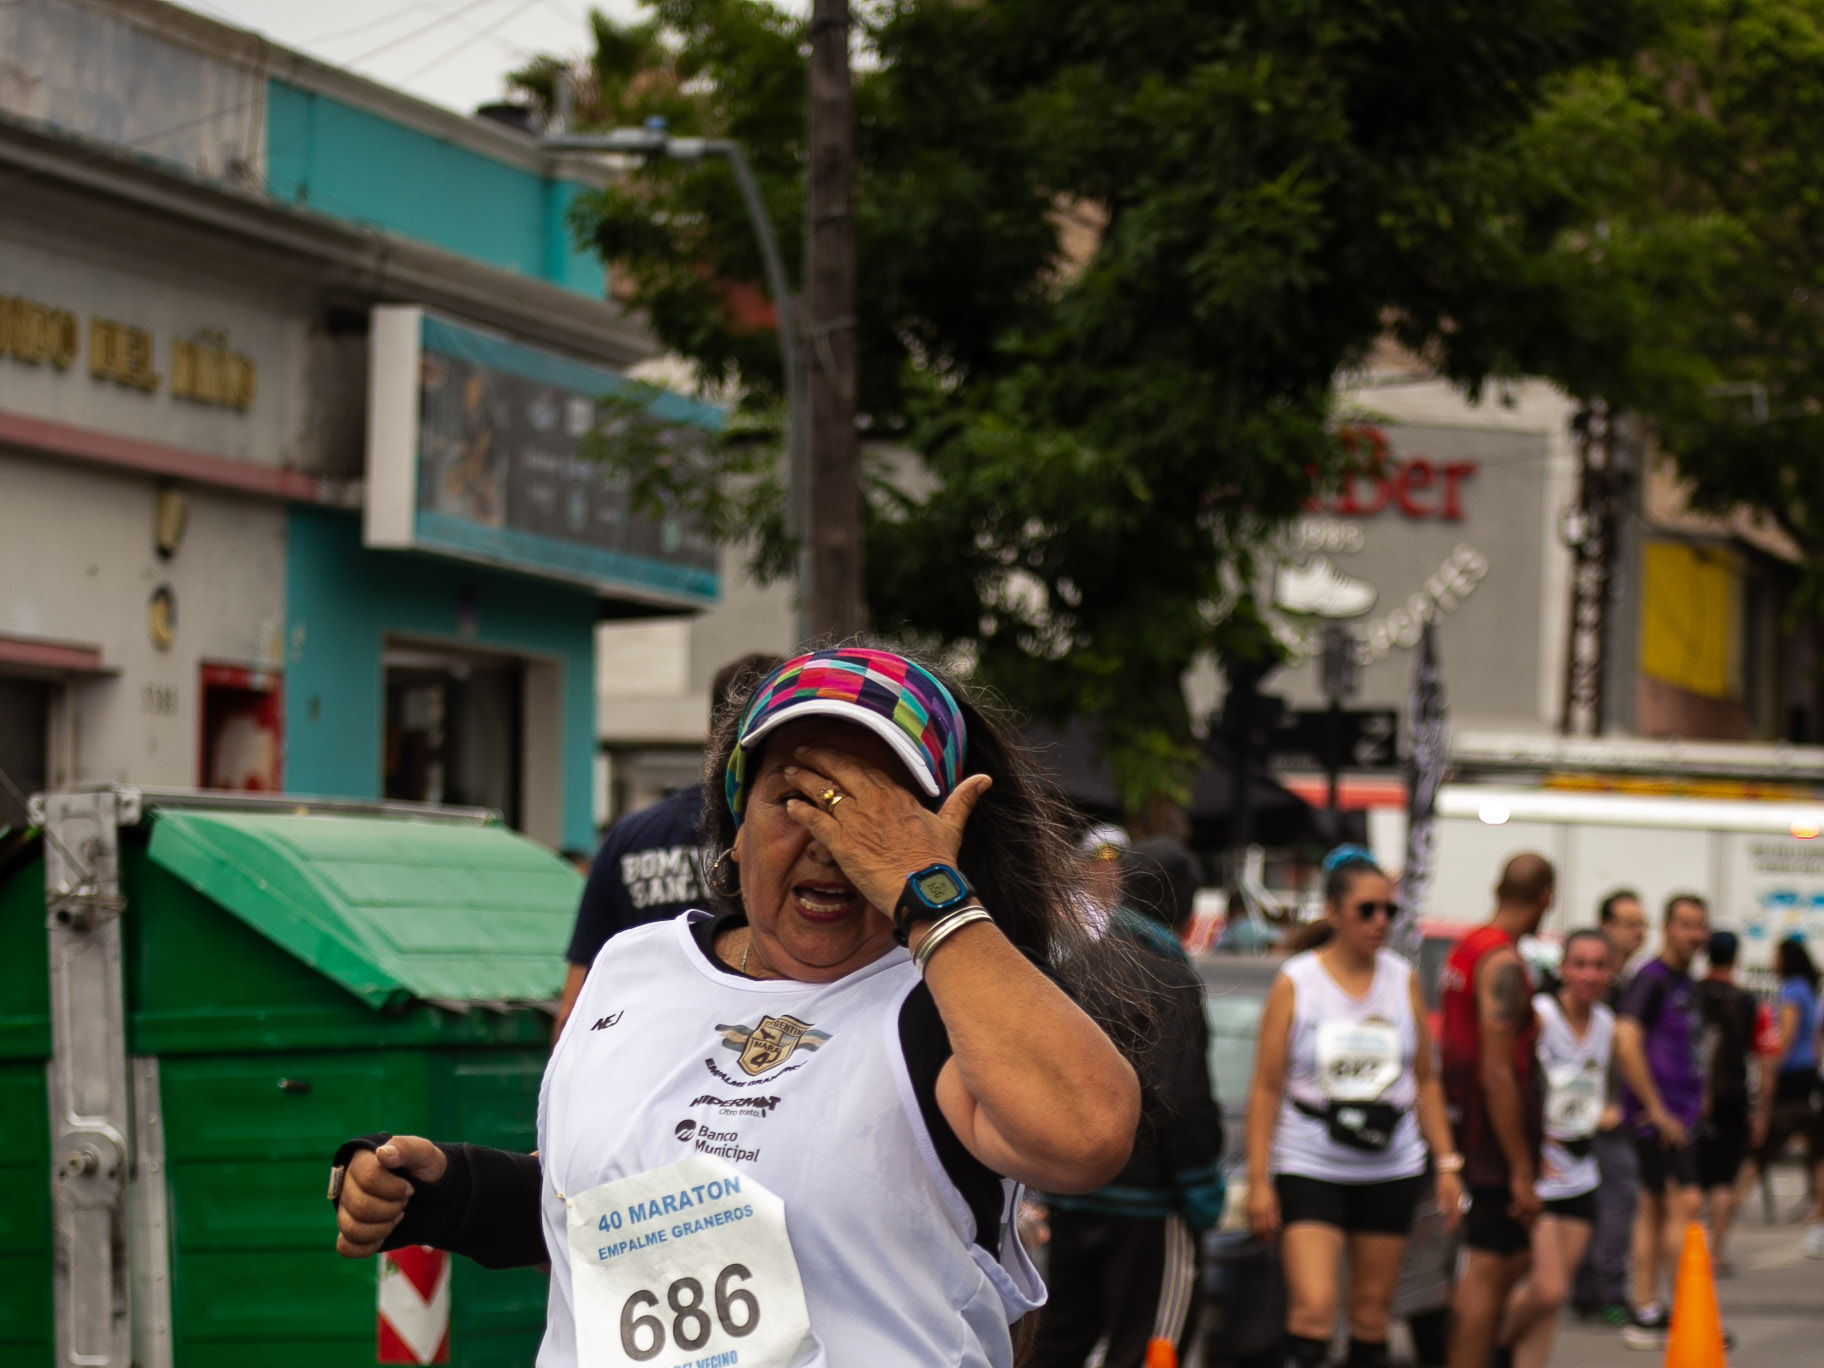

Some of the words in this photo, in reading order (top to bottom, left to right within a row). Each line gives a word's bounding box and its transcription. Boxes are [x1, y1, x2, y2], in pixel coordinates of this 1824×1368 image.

[719, 1108, 737, 1116] Otro
[695, 1139, 760, 1163] Municipal
[698, 1125, 738, 1142] Banco
[598, 1210, 623, 1233] 40
[628, 1176, 742, 1225] MARATON
[598, 1229, 669, 1261] EMPALME
[671, 1204, 755, 1239] GRANEROS
[620, 1263, 761, 1362] 686
